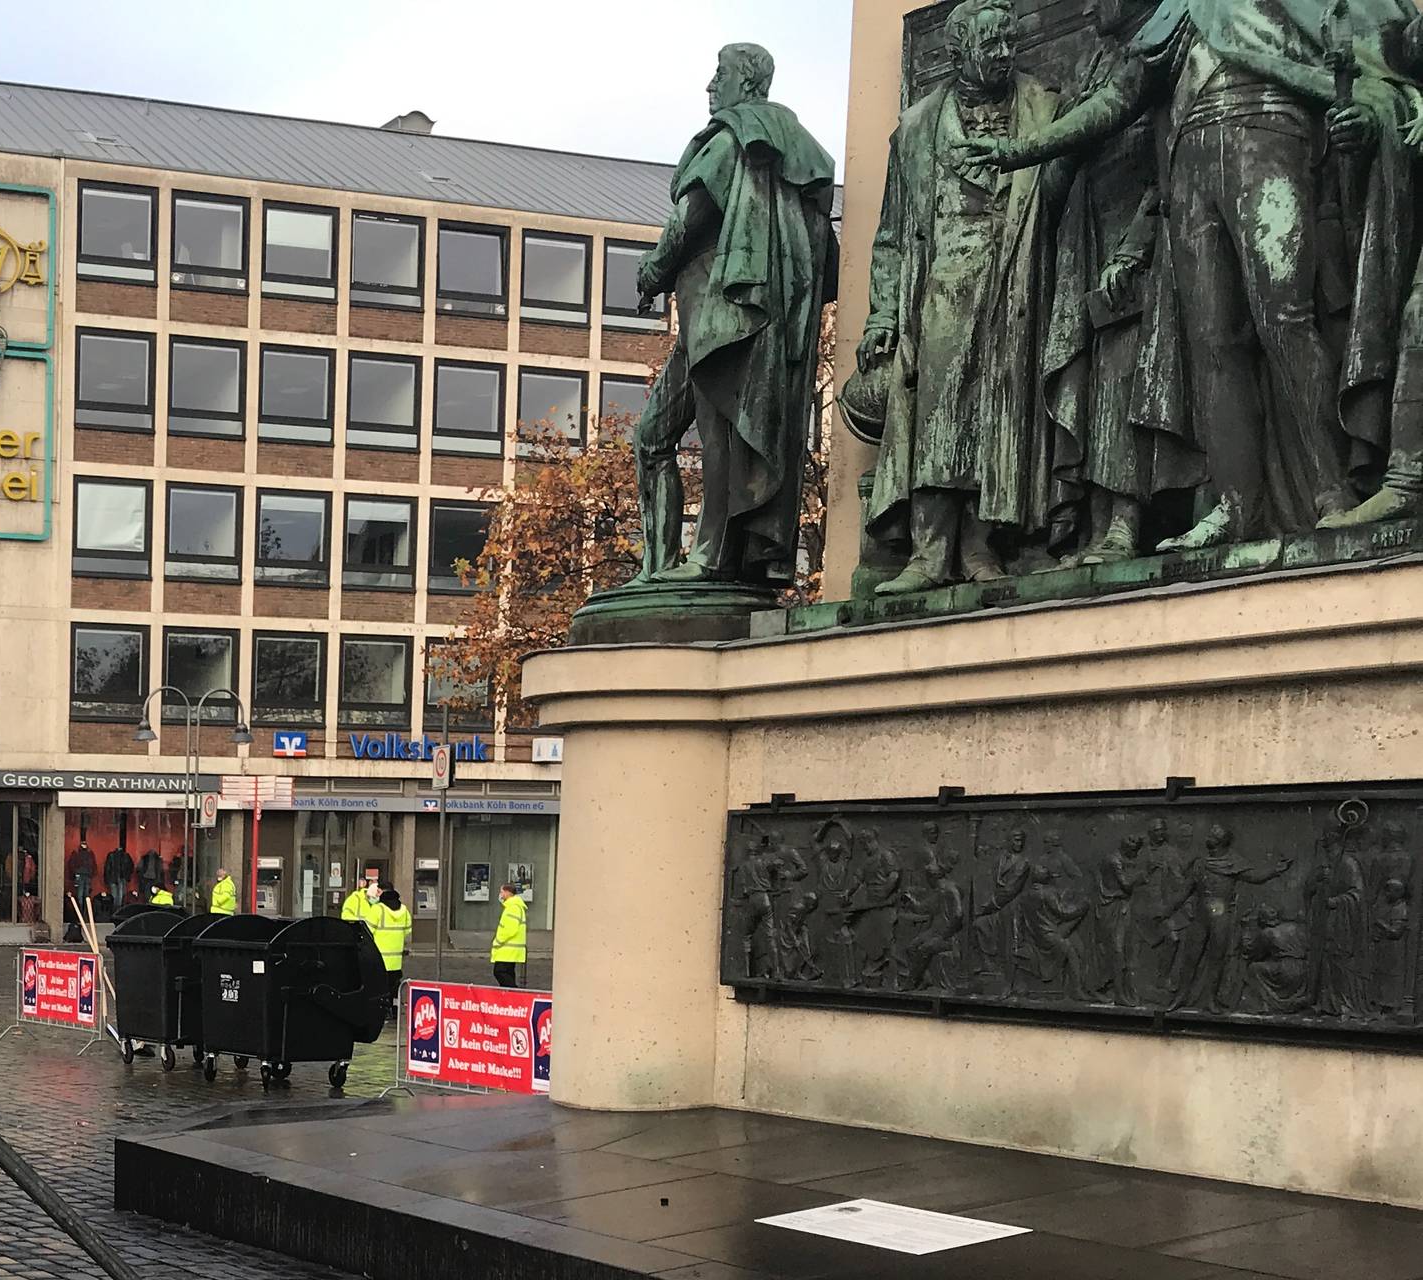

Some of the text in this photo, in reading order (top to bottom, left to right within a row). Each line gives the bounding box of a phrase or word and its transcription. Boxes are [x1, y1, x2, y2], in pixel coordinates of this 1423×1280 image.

[350, 732, 488, 761] Volksbnk
[2, 773, 192, 791] GEORG STRATHMANN
[318, 798, 339, 808] Köln
[341, 799, 364, 808] Bonn
[365, 799, 378, 808] eG
[445, 800, 544, 811] olksbank Köln Bonn eG
[444, 997, 460, 1010] Für
[480, 1001, 528, 1018] Sicherheit!
[414, 1003, 437, 1029] AHA
[470, 1022, 482, 1034] Ab
[461, 1037, 481, 1050] kein
[448, 1057, 469, 1071] Aber
[471, 1062, 486, 1073] mit
